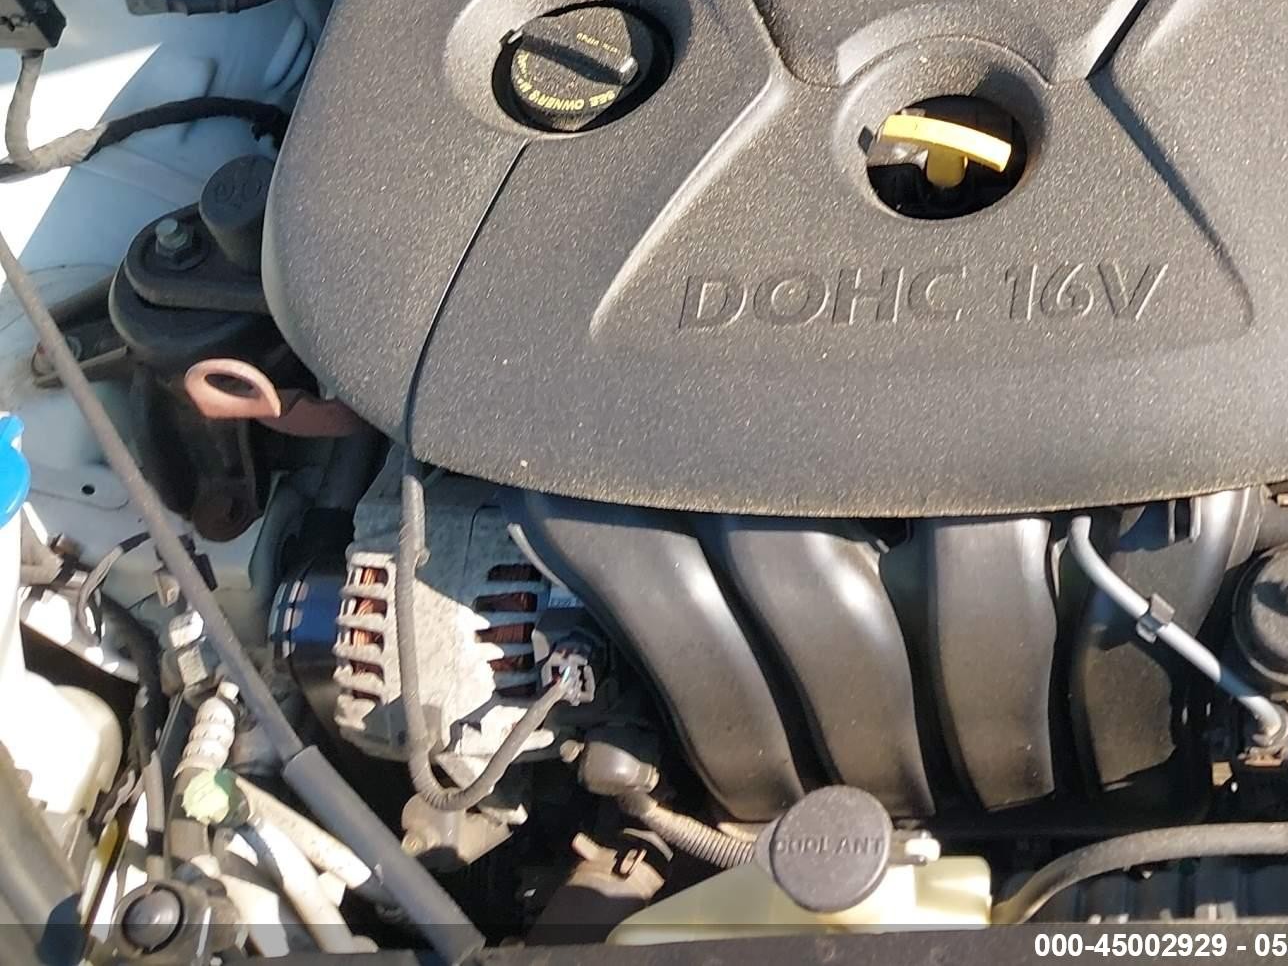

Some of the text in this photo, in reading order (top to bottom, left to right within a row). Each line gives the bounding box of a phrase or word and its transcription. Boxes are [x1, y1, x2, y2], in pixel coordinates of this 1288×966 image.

[678, 261, 1170, 329] DOHC 16V
[775, 834, 884, 855] COOLANT
